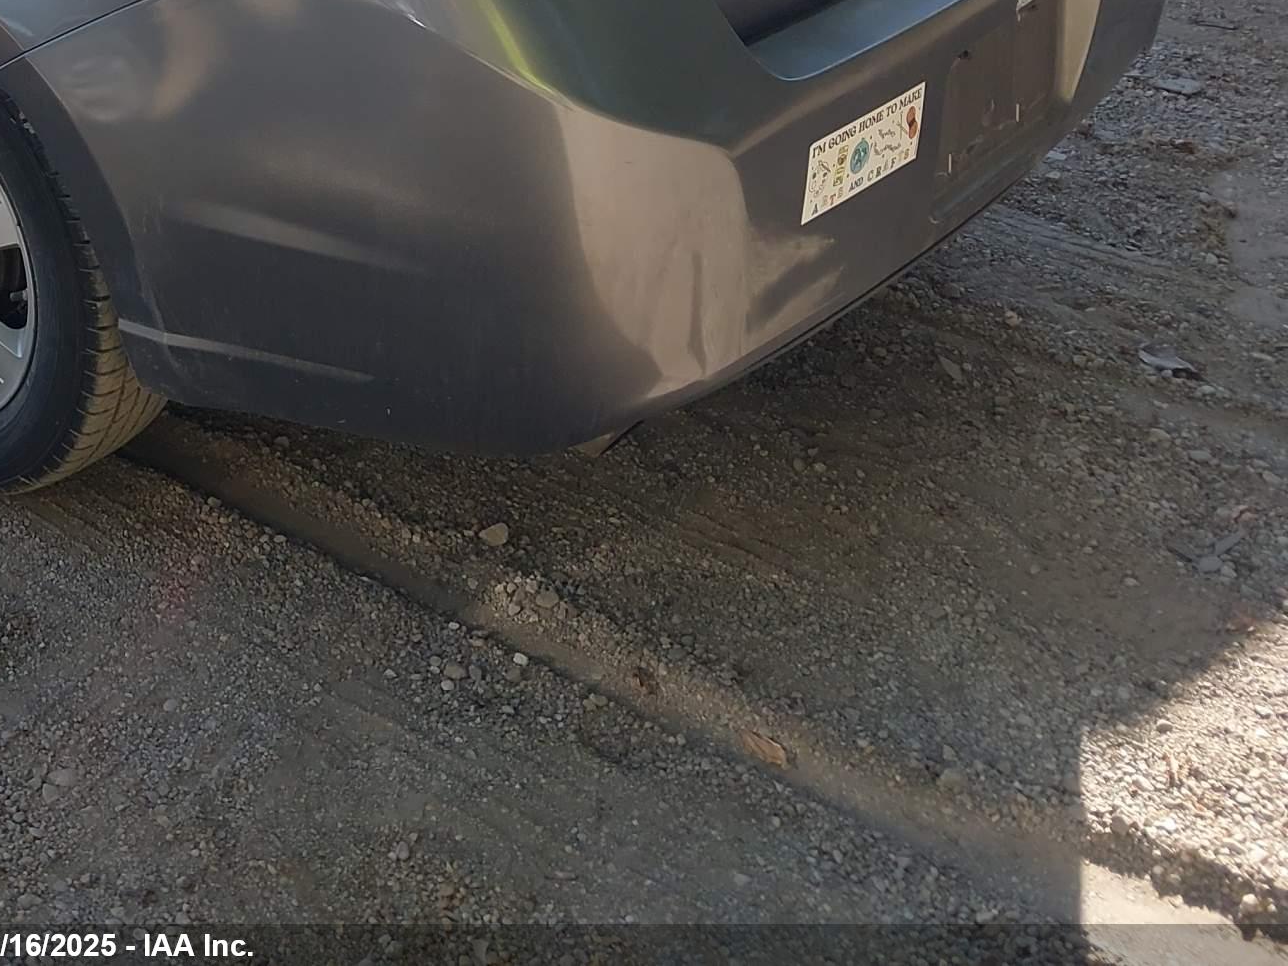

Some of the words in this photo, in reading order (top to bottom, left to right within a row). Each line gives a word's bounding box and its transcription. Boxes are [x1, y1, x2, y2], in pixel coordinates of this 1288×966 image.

[812, 142, 826, 159] I'M
[828, 126, 857, 150] GOING
[858, 111, 884, 134] HOME
[886, 103, 898, 118] TO
[898, 88, 923, 111] MAKE
[848, 176, 864, 193] AND
[867, 148, 910, 182] CRAFTS
